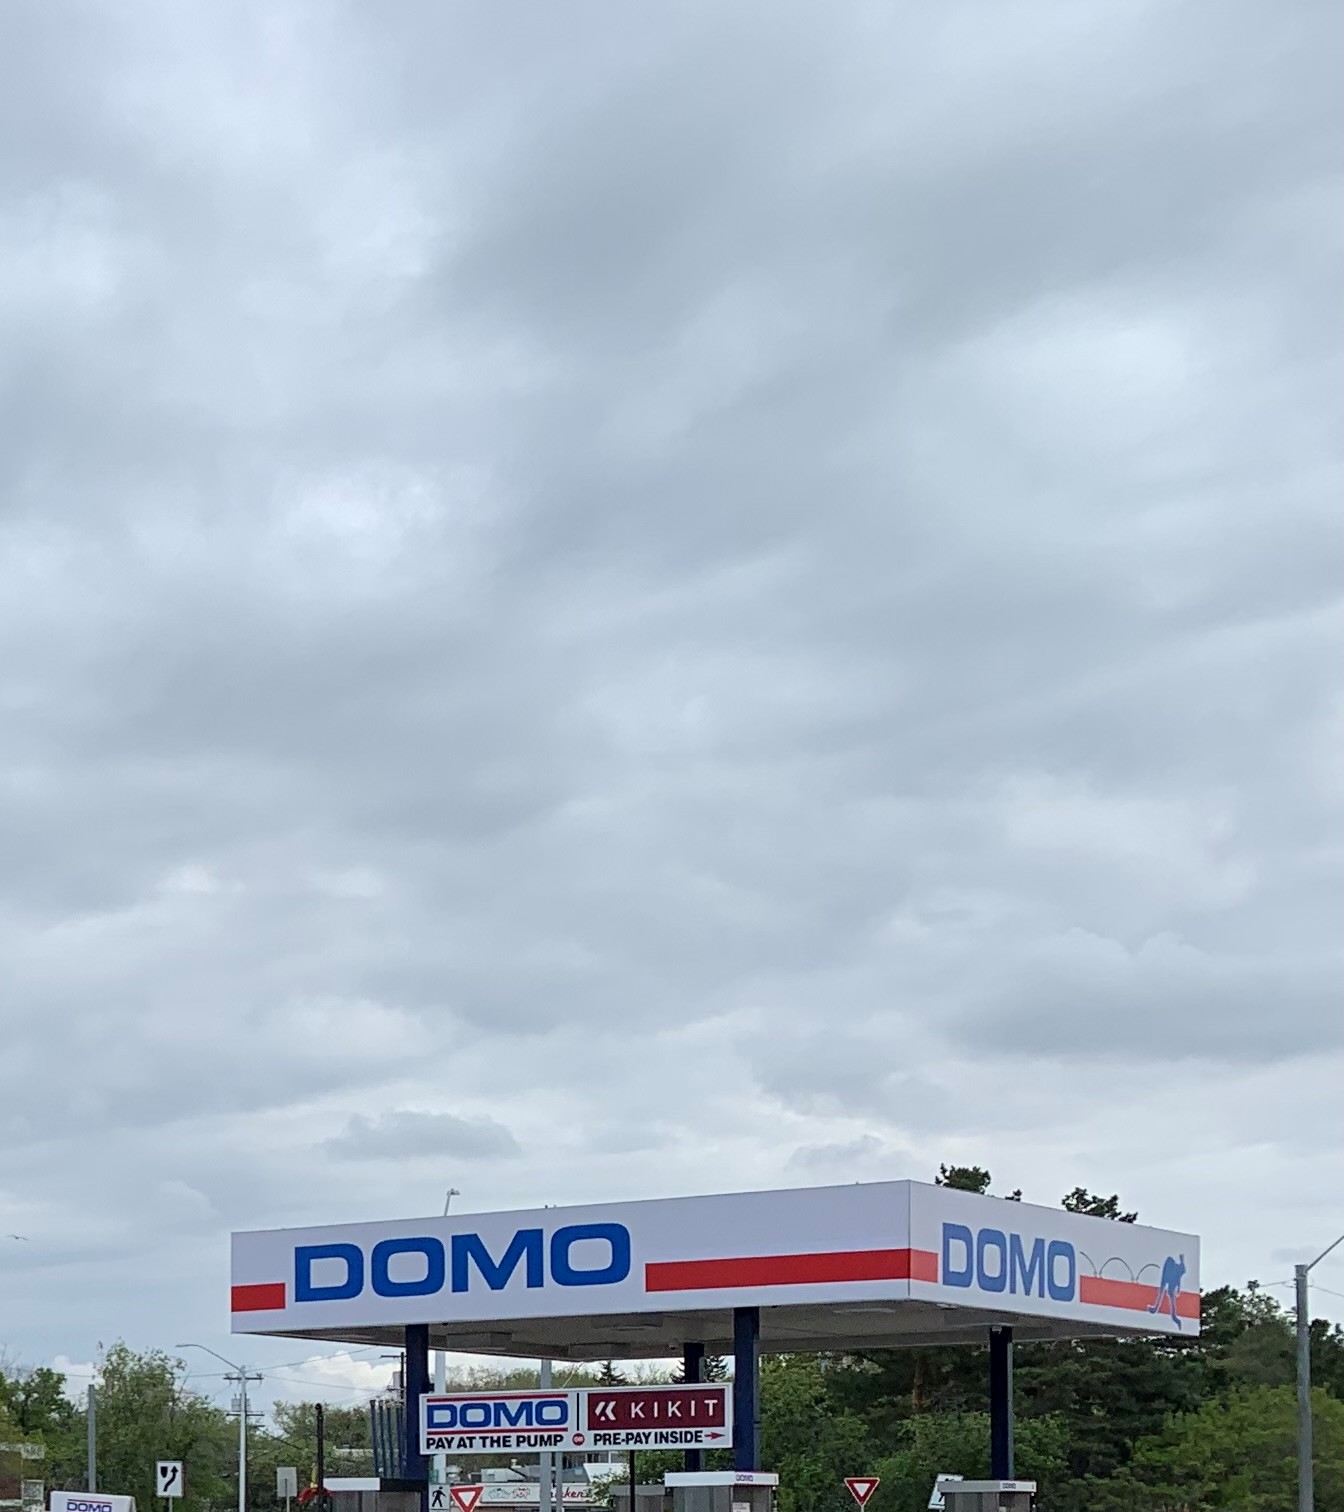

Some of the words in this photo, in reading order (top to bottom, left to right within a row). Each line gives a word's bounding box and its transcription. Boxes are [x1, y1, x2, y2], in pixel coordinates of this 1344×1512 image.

[295, 1222, 631, 1303] DOMO
[942, 1222, 1076, 1303] DOMO
[426, 1399, 569, 1429] DOMO
[630, 1399, 718, 1419] KIKIT
[426, 1436, 459, 1449] PAY
[460, 1436, 477, 1449] AT
[479, 1435, 512, 1449] THE
[516, 1434, 564, 1447] PUMP
[593, 1432, 653, 1445] PRE-PAY
[654, 1430, 703, 1444] INSIDE
